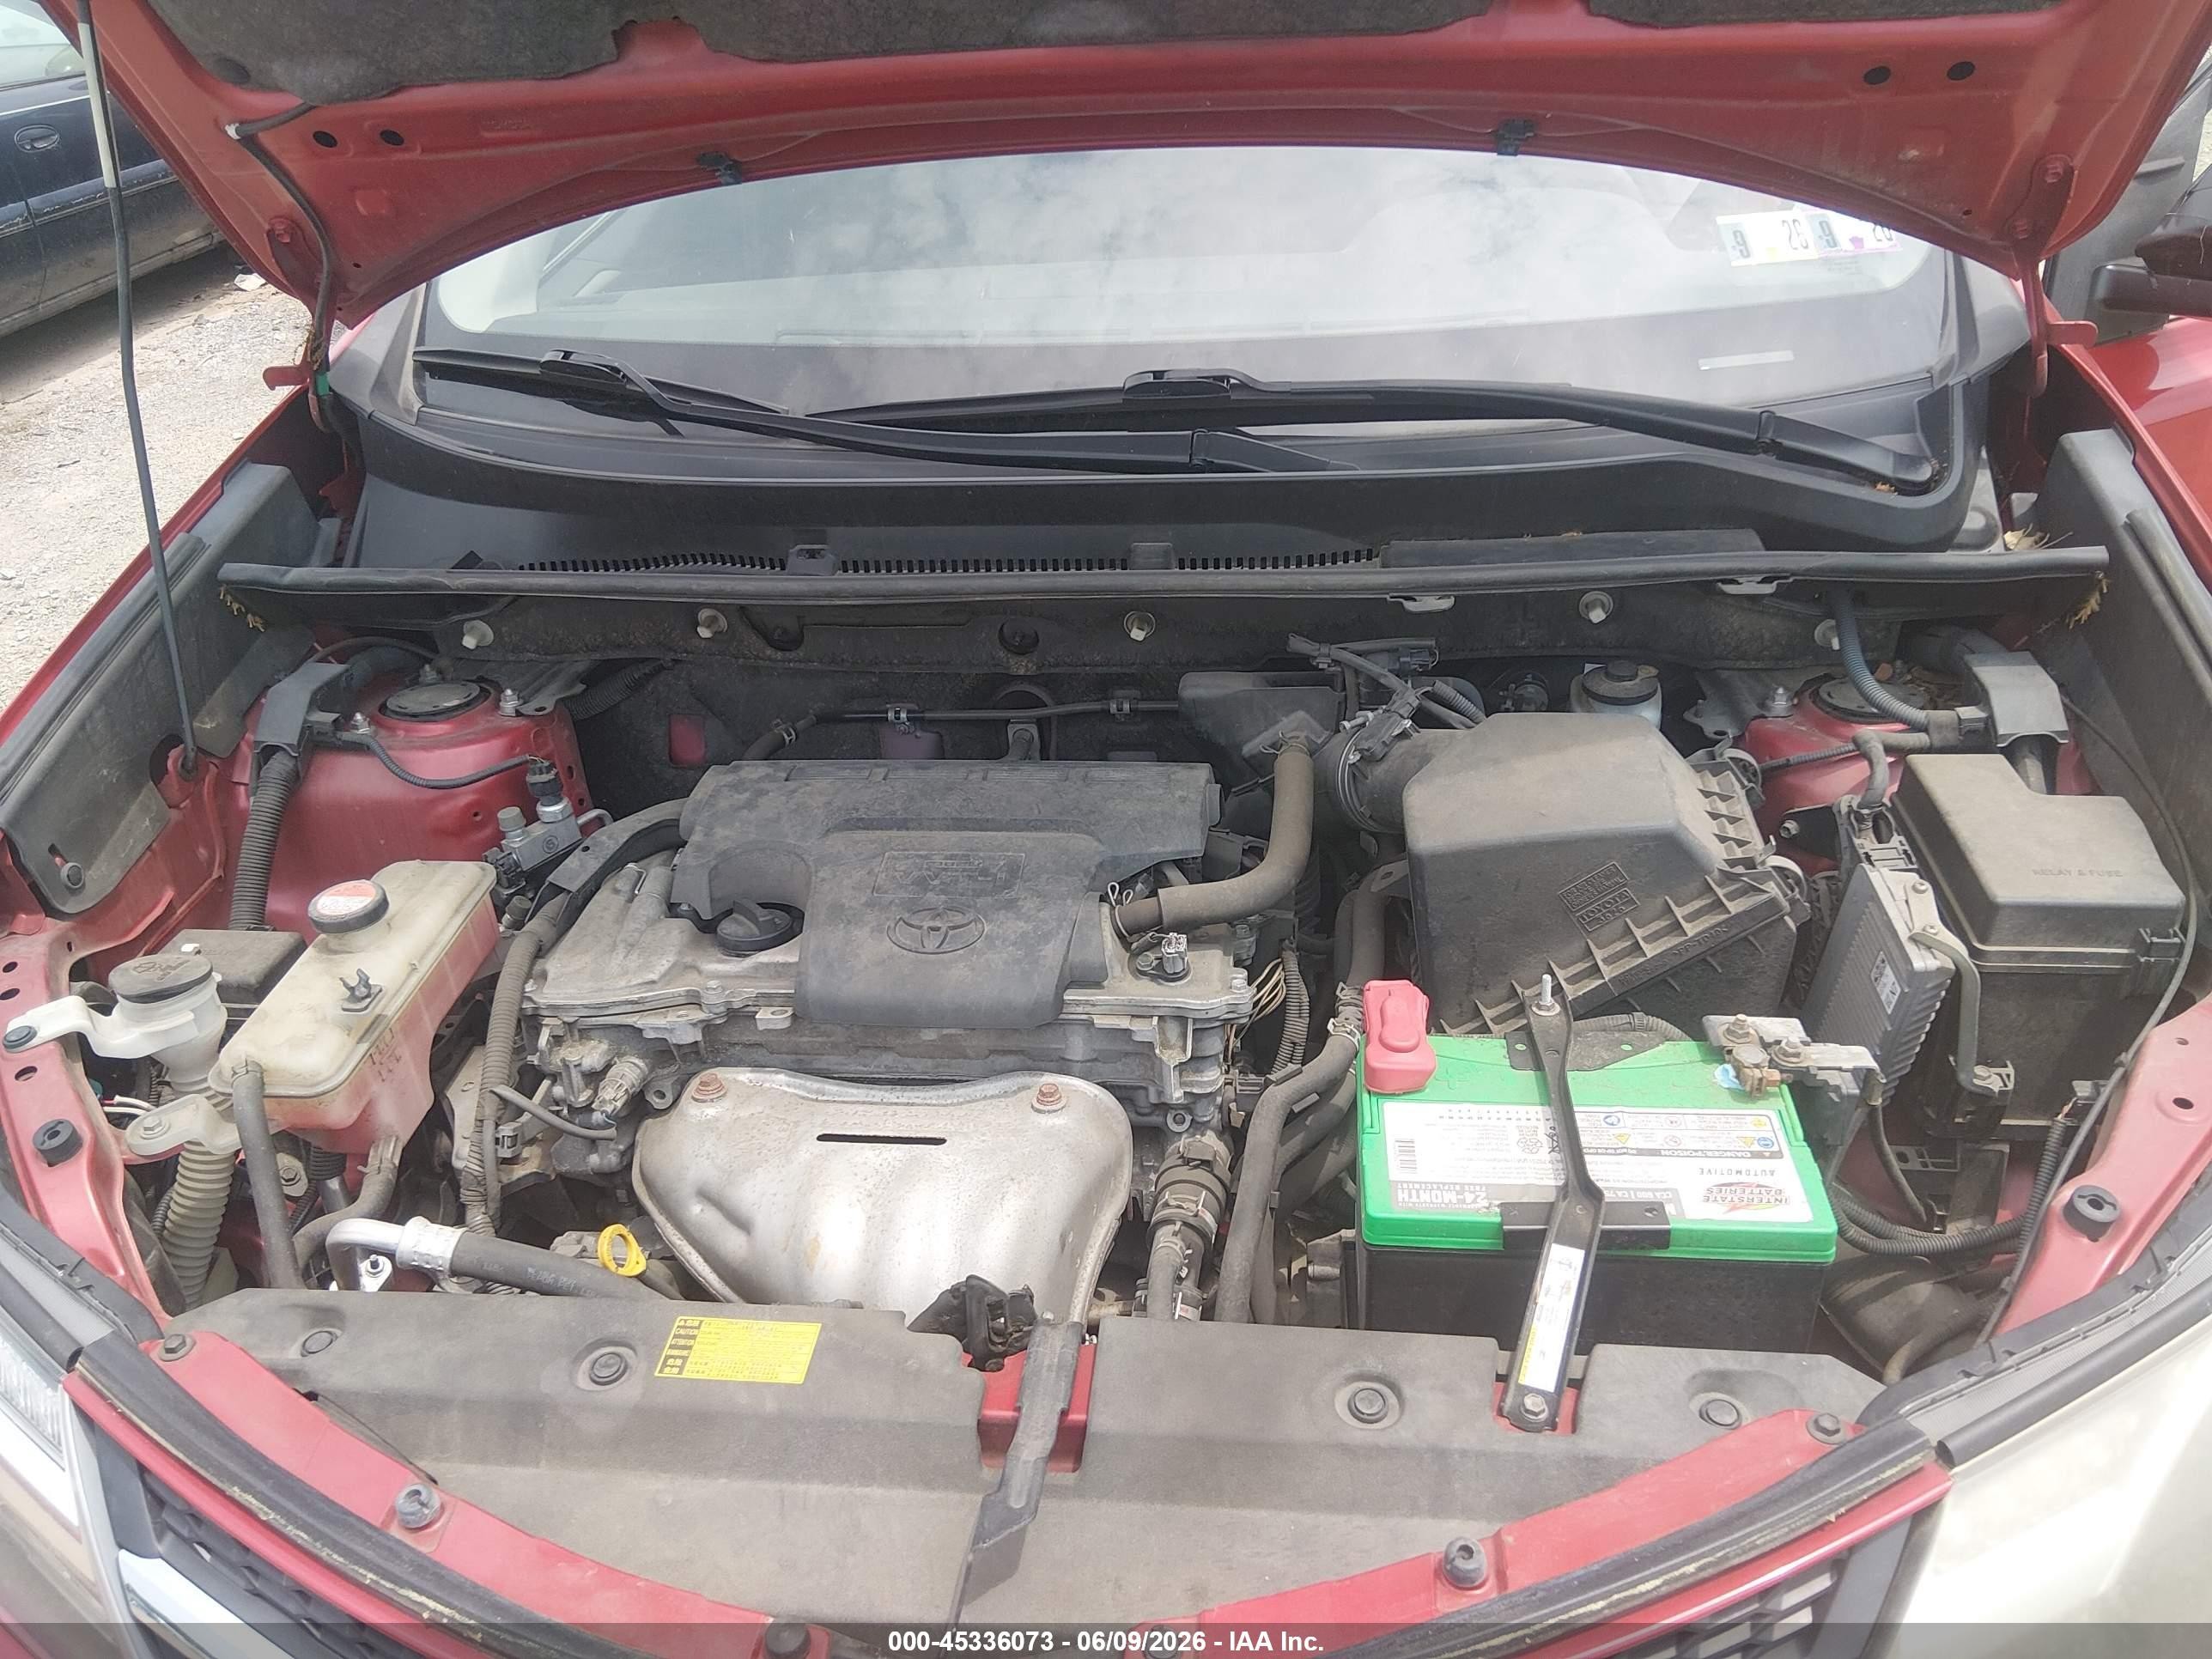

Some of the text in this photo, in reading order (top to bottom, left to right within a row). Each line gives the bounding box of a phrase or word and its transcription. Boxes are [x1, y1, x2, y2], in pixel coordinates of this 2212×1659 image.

[1579, 891, 1630, 921] TOYOTA
[1698, 1167, 1776, 1177] AUTOMOTIVE
[1397, 1189, 1488, 1204] 24-MONTH
[1706, 1187, 1784, 1195] BATTERIES
[1703, 1194, 1790, 1205] INTERSTATE
